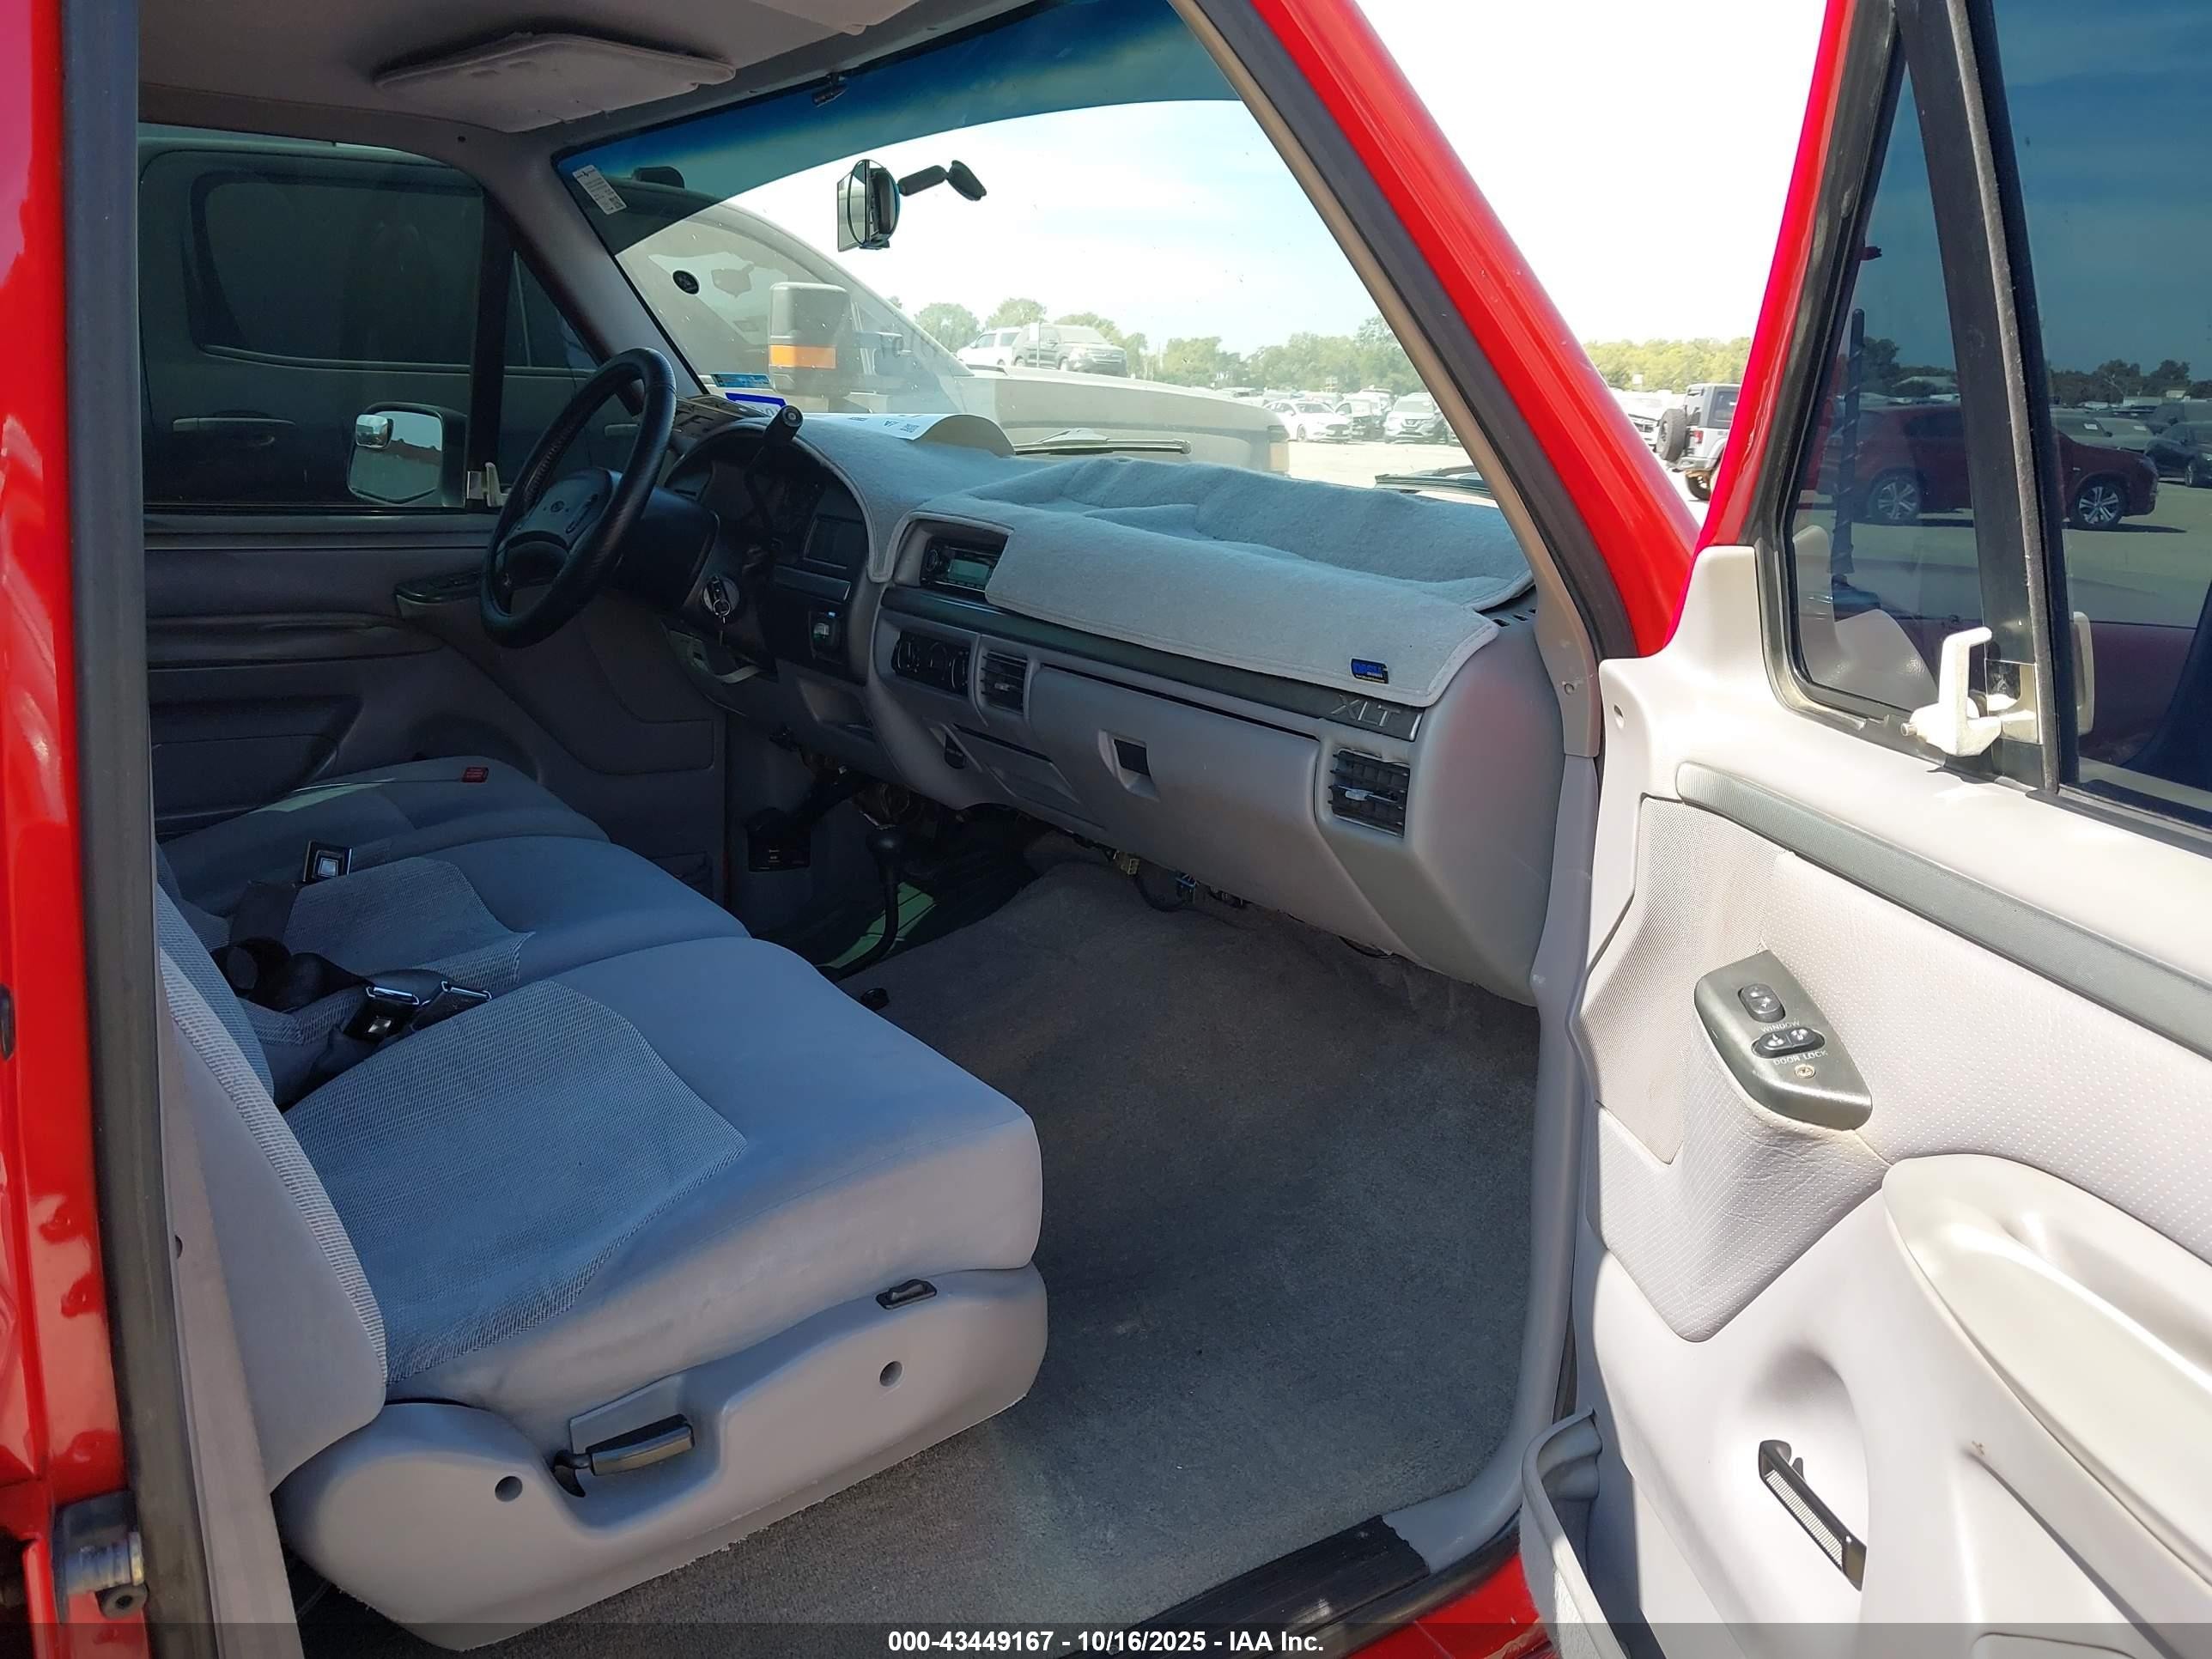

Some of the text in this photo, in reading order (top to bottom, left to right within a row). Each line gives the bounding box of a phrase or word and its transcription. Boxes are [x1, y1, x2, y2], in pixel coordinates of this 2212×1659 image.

[1331, 694, 1401, 727] XLT
[1761, 1019, 1800, 1032] WINDOW
[1773, 1049, 1827, 1066] DOOR LOCK
